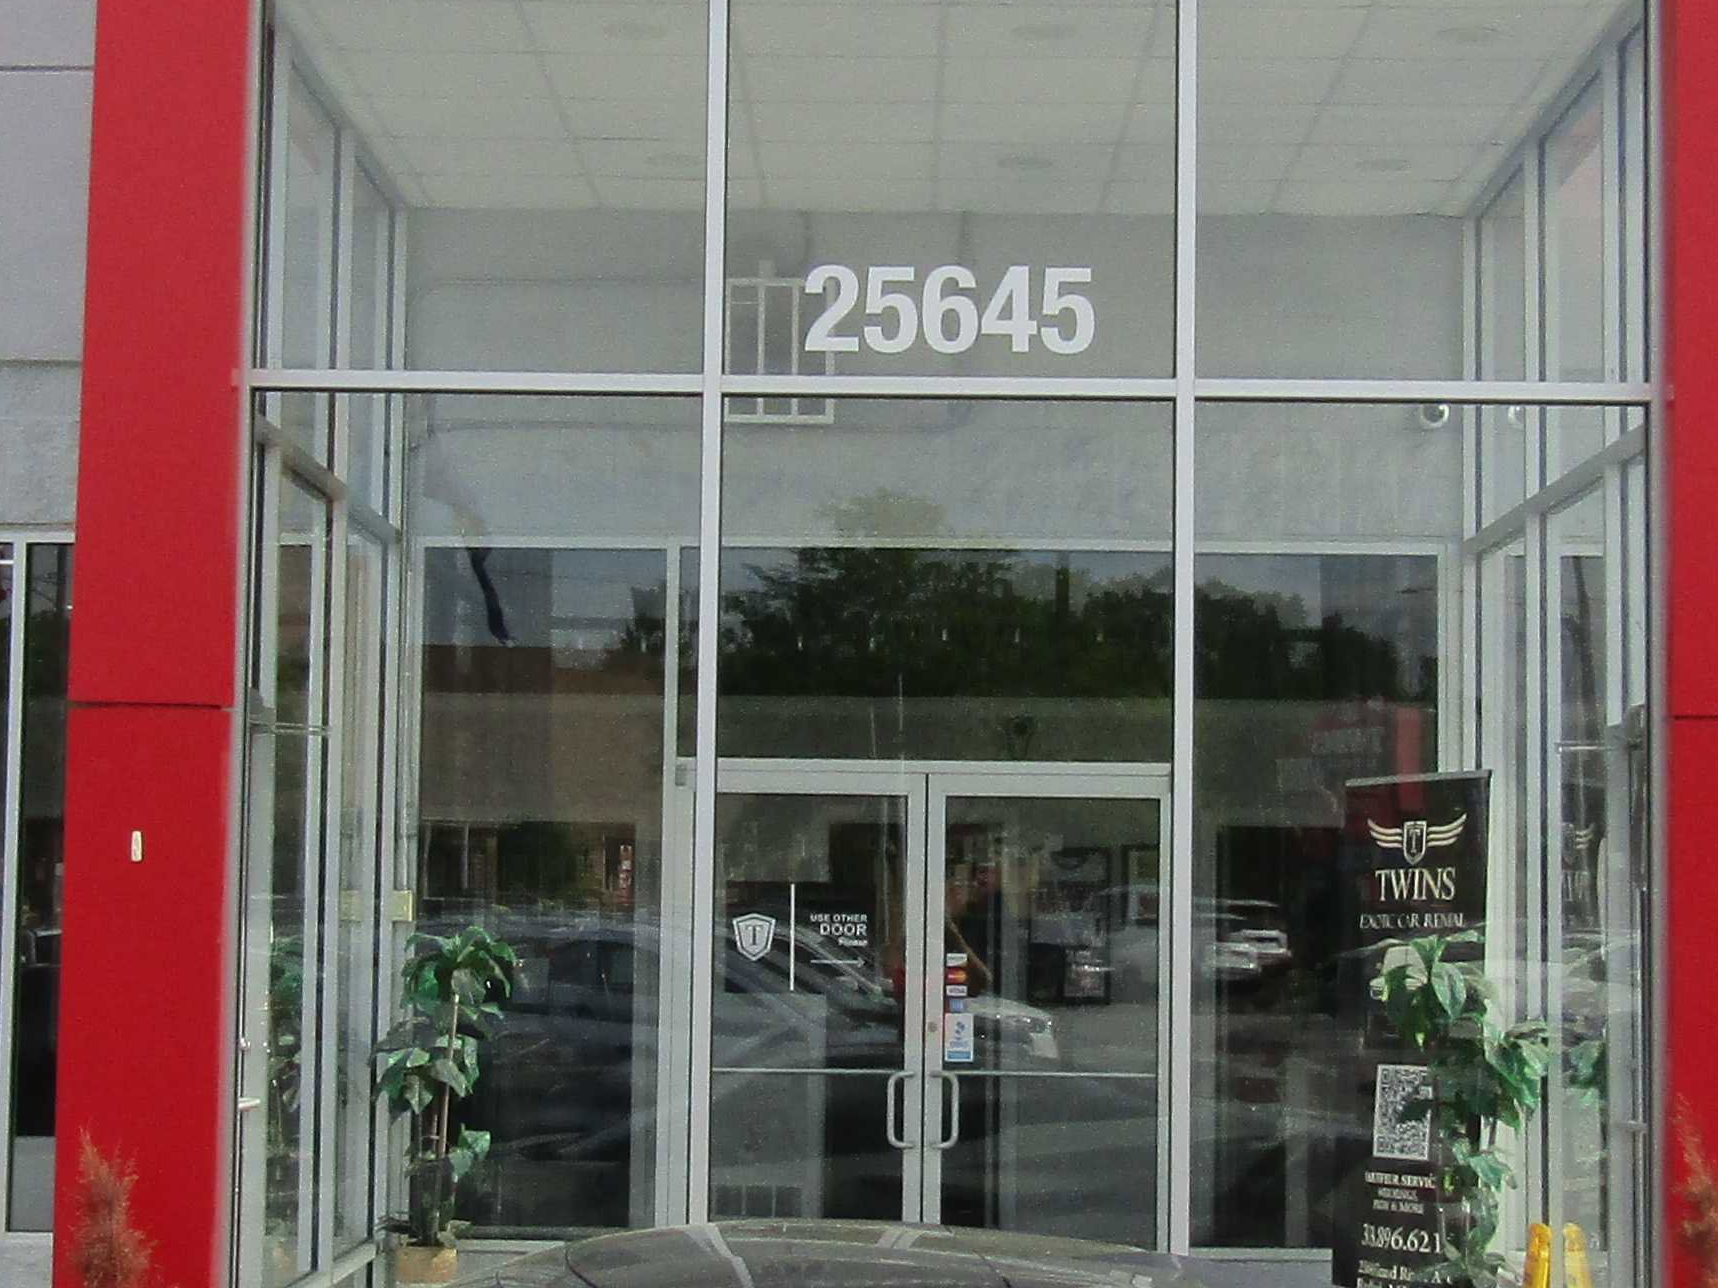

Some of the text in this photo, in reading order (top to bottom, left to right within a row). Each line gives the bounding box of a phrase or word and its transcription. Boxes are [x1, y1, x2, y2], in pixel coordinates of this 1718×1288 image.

[804, 264, 1095, 354] 25645
[1375, 867, 1456, 901] TWINS
[810, 913, 868, 922] USE OTHER
[820, 923, 868, 936] DOOR
